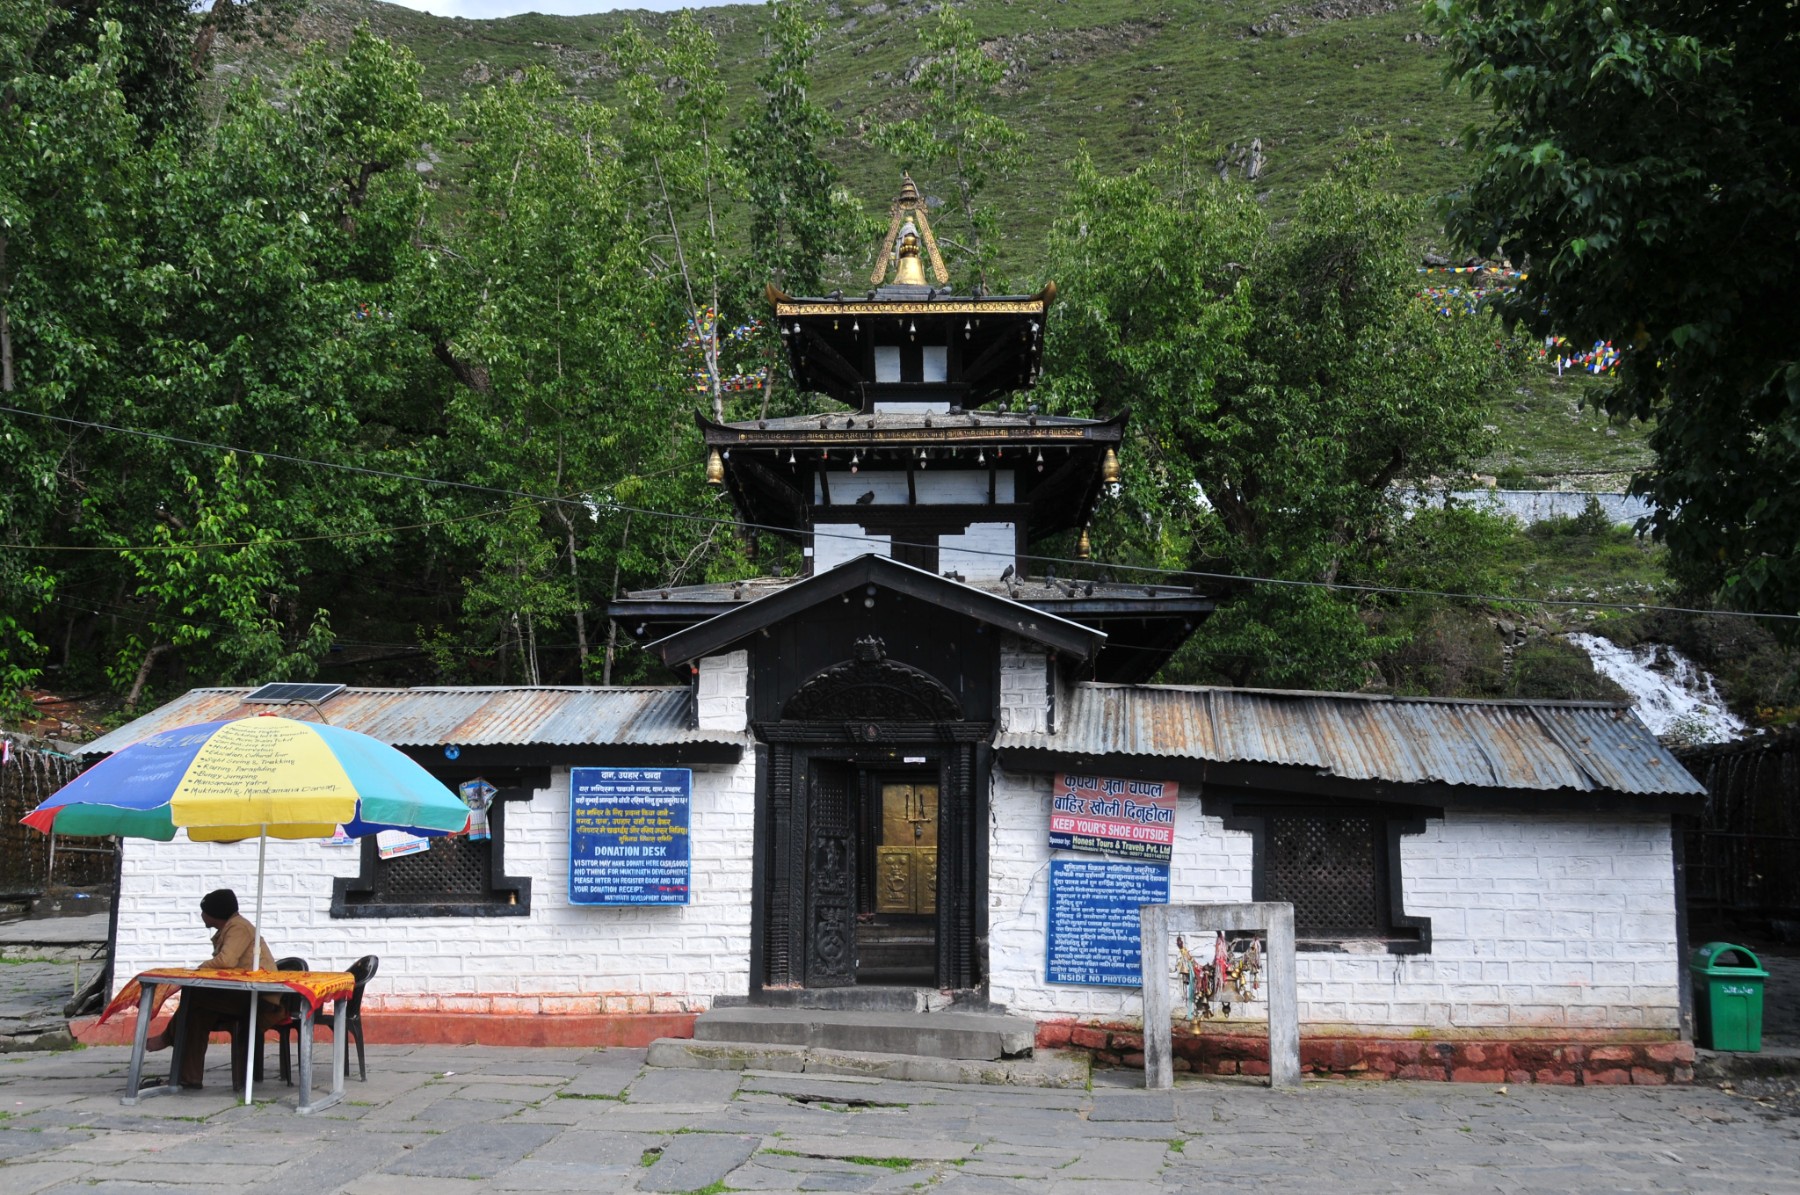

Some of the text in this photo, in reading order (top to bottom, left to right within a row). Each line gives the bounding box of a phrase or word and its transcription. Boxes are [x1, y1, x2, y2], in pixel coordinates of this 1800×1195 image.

[1128, 781, 1164, 798] चप्पल
[1054, 794, 1174, 825] बाहिर खोली दिनुहोला
[1053, 818, 1170, 841] KEEP YOUR'S SHOE OUTSIDE
[595, 846, 666, 856] DONATION DESK
[1049, 836, 1064, 845] Sponsor
[1072, 836, 1095, 846] Honest
[1096, 838, 1114, 848] Tours
[1115, 840, 1120, 848] &
[1122, 841, 1145, 852] Travels
[1160, 844, 1171, 854] Ltd
[574, 859, 599, 867] VISITOR
[599, 859, 611, 867] MAY
[574, 868, 586, 876] AND
[586, 868, 606, 876] THING
[608, 868, 619, 876] FOR
[620, 868, 650, 876] MUKTINATH
[1058, 974, 1086, 982] INSIDE
